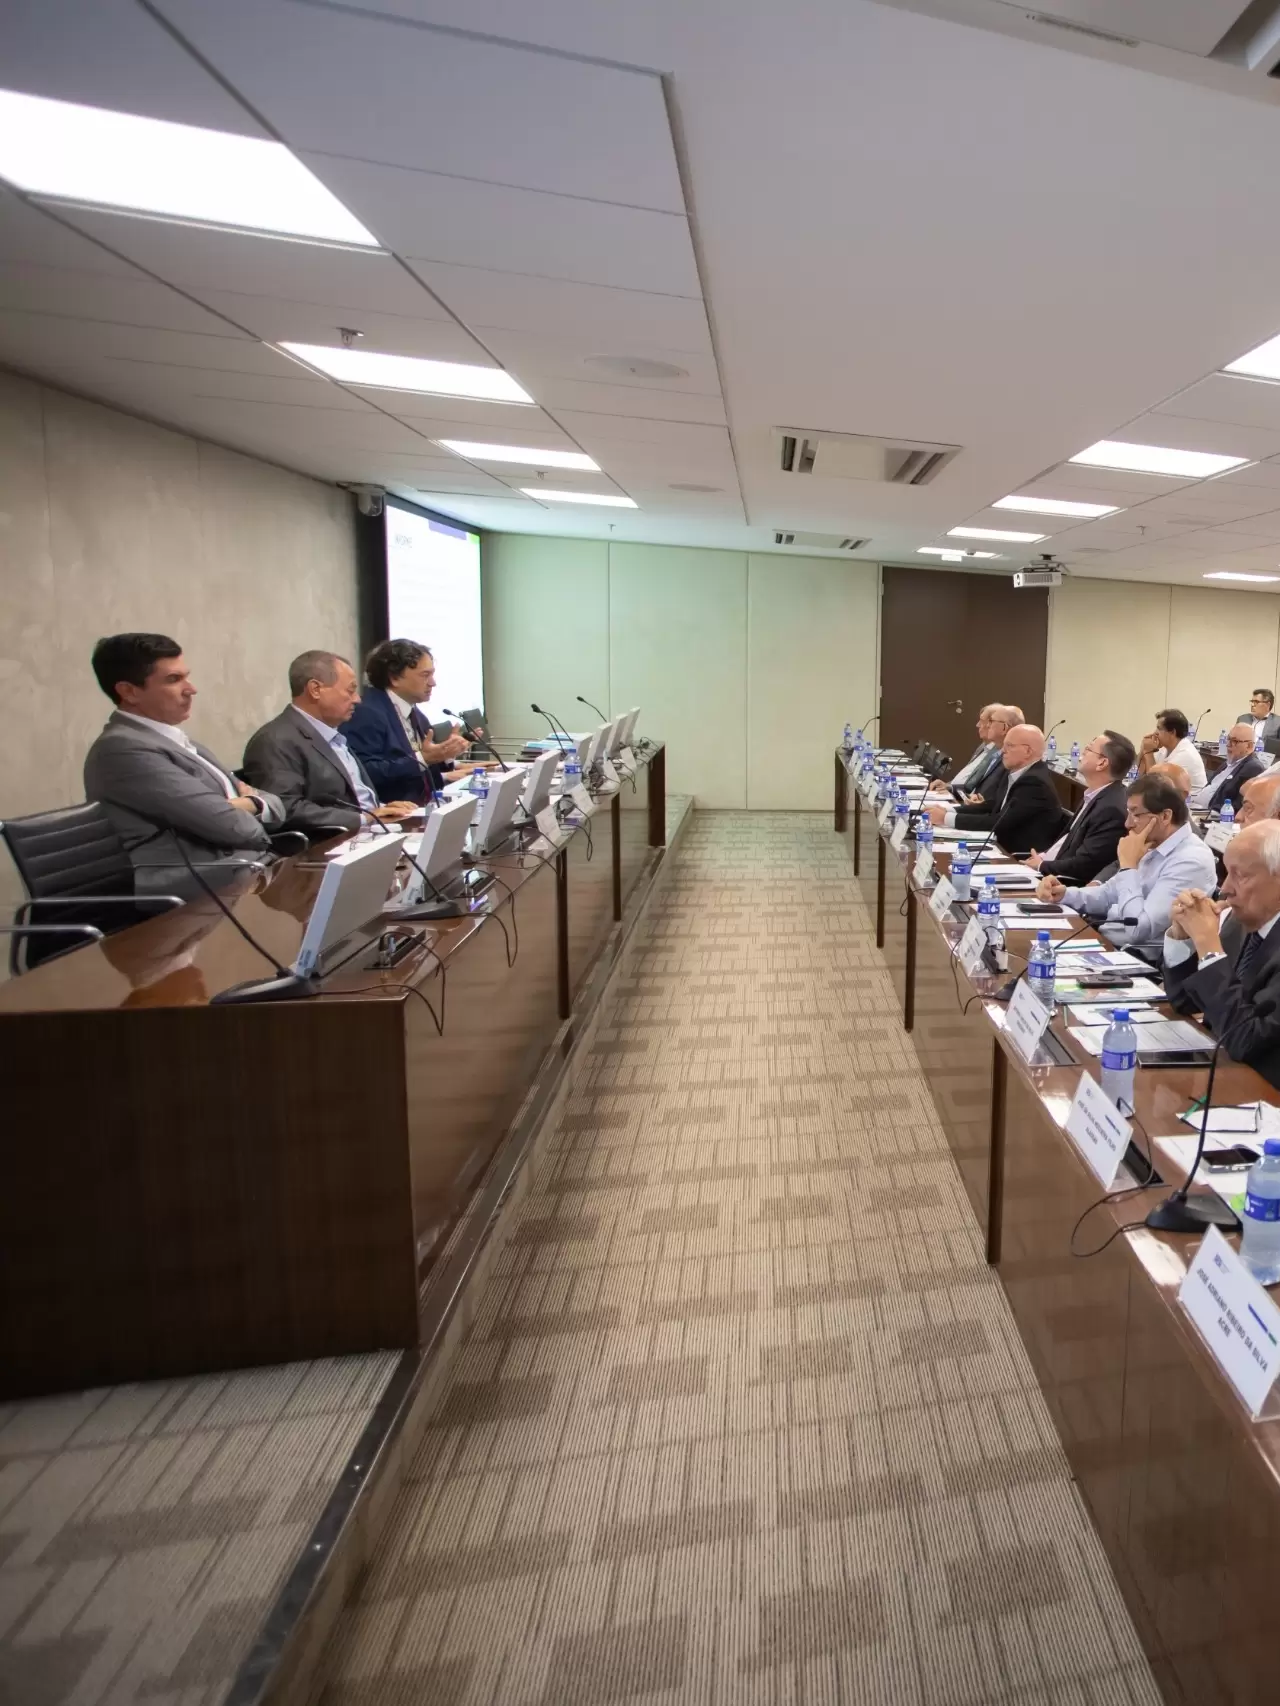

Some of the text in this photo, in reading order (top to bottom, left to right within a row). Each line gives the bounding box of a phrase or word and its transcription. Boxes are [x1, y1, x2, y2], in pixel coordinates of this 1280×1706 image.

[1208, 1283, 1227, 1312] ADRIANO
[1226, 1308, 1246, 1339] RIBEIRO
[1244, 1336, 1253, 1350] DA
[1252, 1347, 1268, 1373] SILVA
[1217, 1316, 1231, 1338] ACRE
